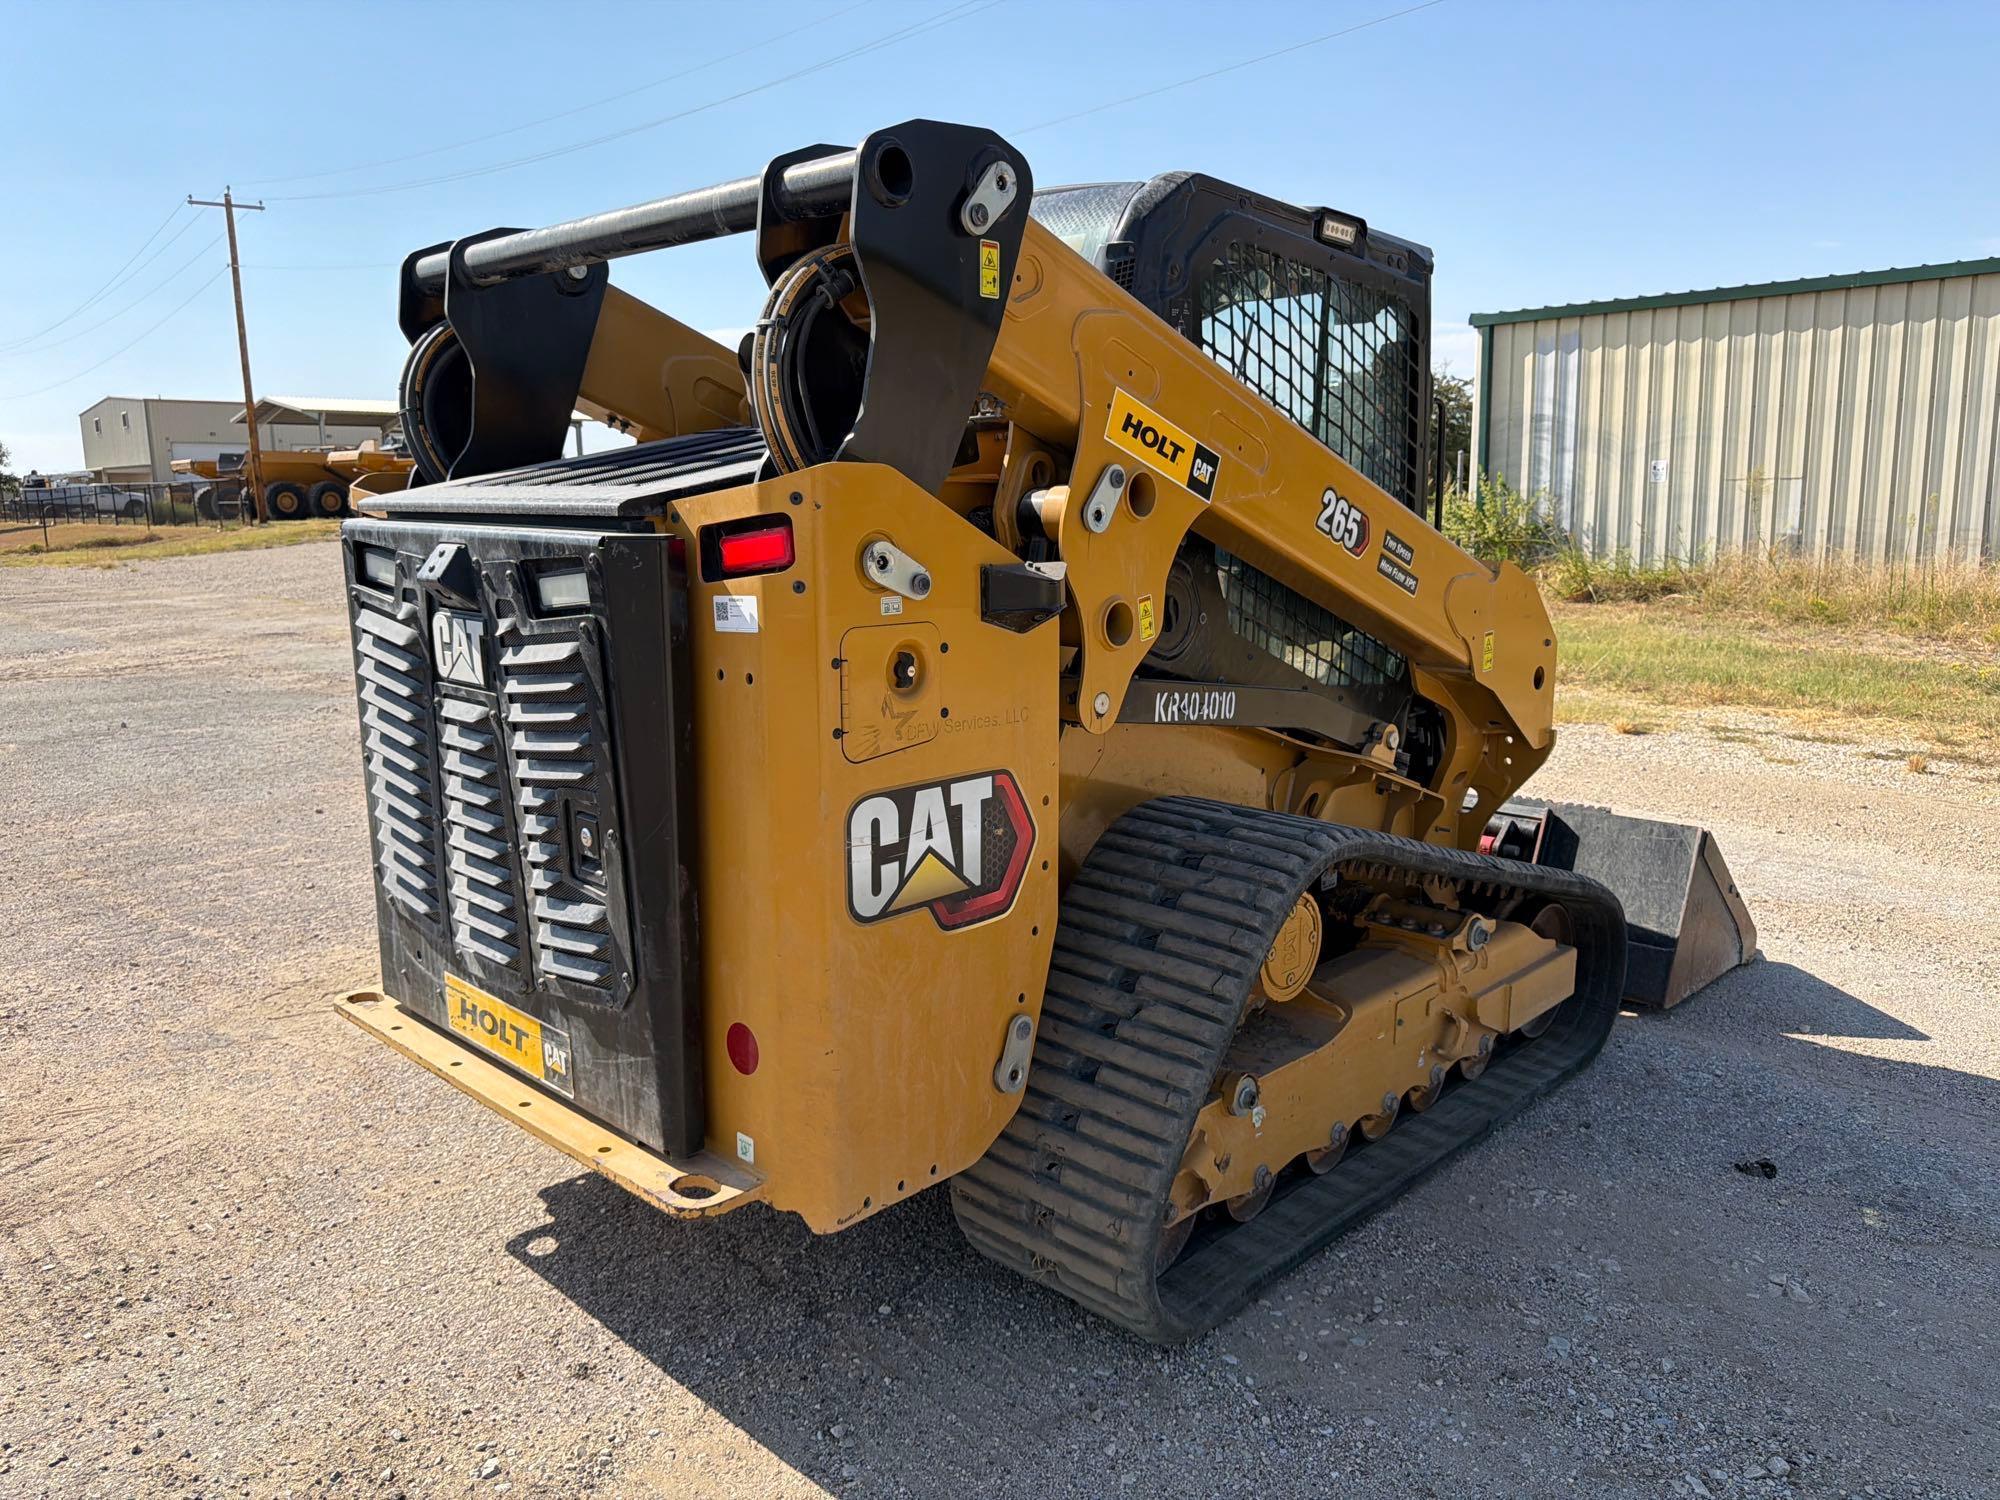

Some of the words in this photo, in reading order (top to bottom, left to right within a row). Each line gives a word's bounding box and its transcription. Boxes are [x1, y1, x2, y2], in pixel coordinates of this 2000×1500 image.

[1121, 412, 1186, 465] HOLT
[1192, 457, 1214, 485] CAT
[1317, 489, 1361, 549] 265
[431, 610, 485, 686] CAT
[1005, 706, 1030, 725] LLC
[1155, 691, 1236, 723] KR404010
[850, 774, 993, 917] CAT
[460, 997, 530, 1053] HOLT
[544, 1042, 567, 1076] CAT
